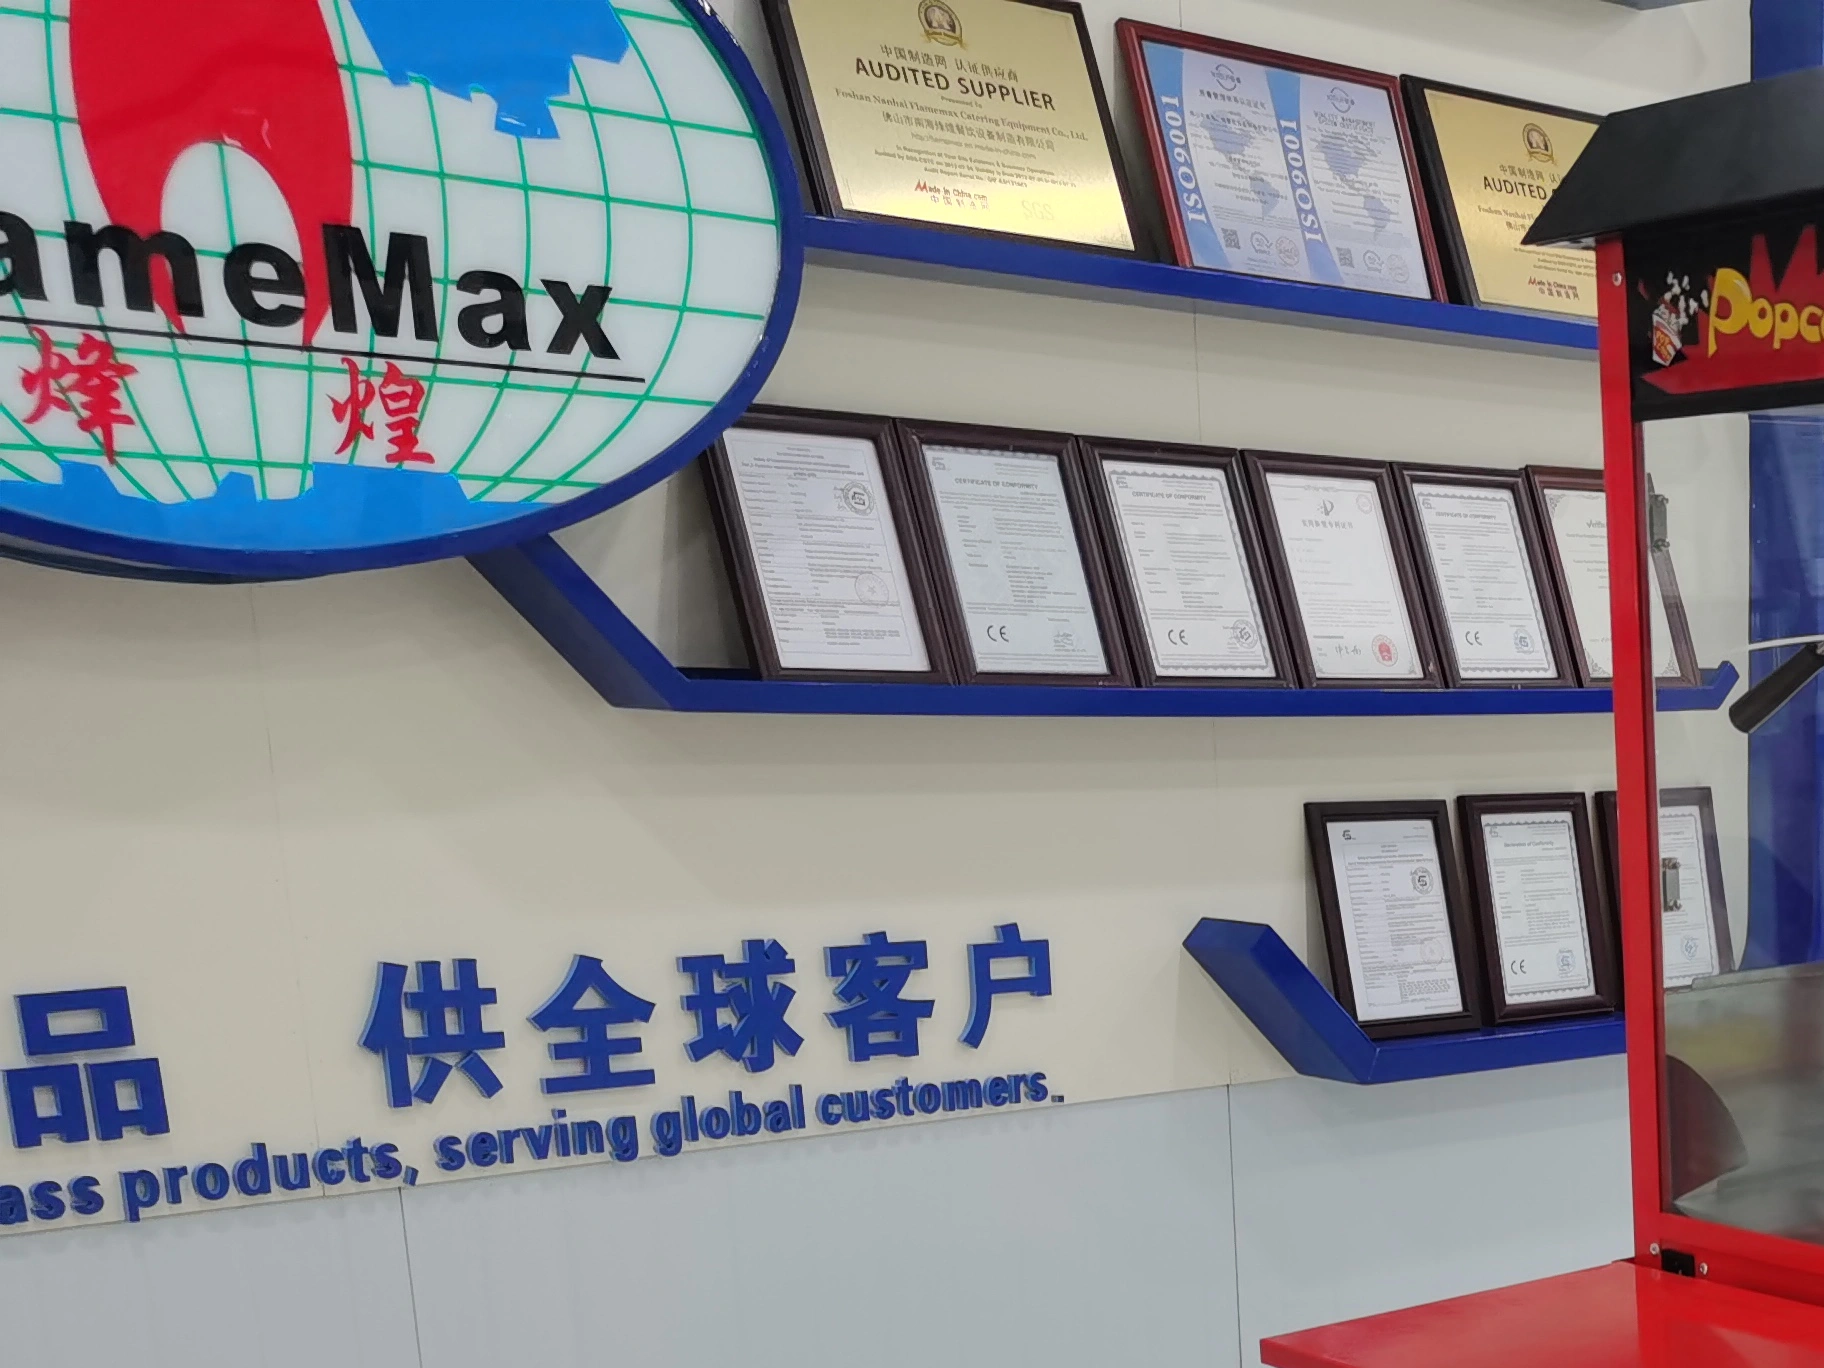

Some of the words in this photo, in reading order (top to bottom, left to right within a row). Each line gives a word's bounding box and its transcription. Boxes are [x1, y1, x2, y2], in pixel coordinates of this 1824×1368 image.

[834, 88, 871, 103] Foshan
[873, 95, 908, 110] Nanhai
[961, 109, 999, 127] Catering
[1000, 118, 1051, 137] Equipment
[855, 57, 949, 91] AUDITED
[958, 77, 1056, 111] SUPPLIER
[1022, 199, 1055, 222] SGS
[1161, 94, 1207, 224] ISO9001
[1280, 119, 1324, 243] ISO9001
[1483, 175, 1547, 201] AUDITED
[0, 211, 622, 361] ameMax
[1, 986, 170, 1149] 品
[357, 922, 1053, 1109] 供全球客户
[118, 1137, 420, 1223] products,
[434, 1108, 639, 1172] serving
[653, 1084, 806, 1157] global
[817, 1070, 1065, 1126] customers.
